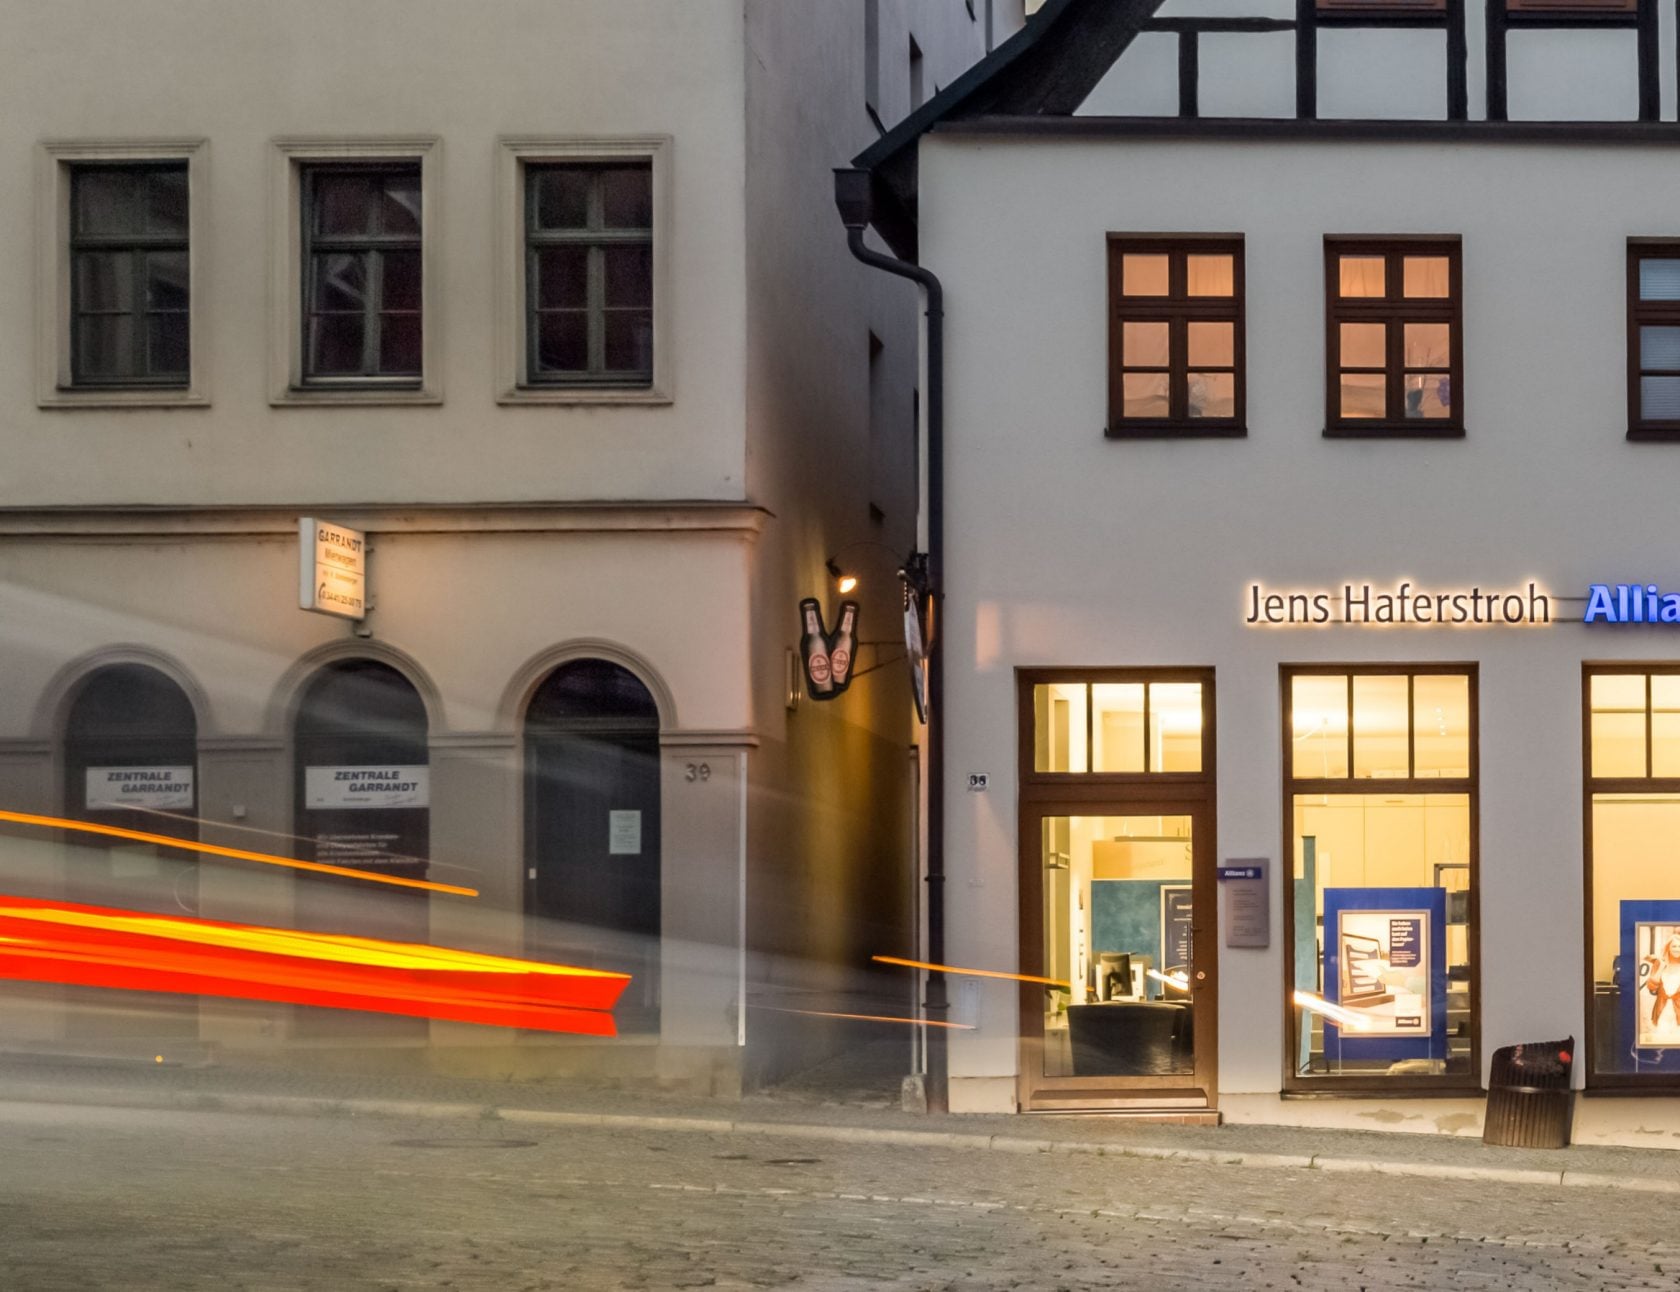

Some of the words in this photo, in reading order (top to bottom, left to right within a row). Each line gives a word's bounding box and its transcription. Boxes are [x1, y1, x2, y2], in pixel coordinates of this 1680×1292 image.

[318, 529, 361, 552] GARRANDT
[1246, 584, 1329, 623] Jens
[1343, 583, 1550, 623] Haferstroh
[107, 771, 172, 782] ZENTRALE
[334, 770, 400, 781] ZENTRALE
[685, 762, 711, 783] 39
[121, 783, 190, 793] GARRANDT
[348, 782, 418, 792] GARRANDT
